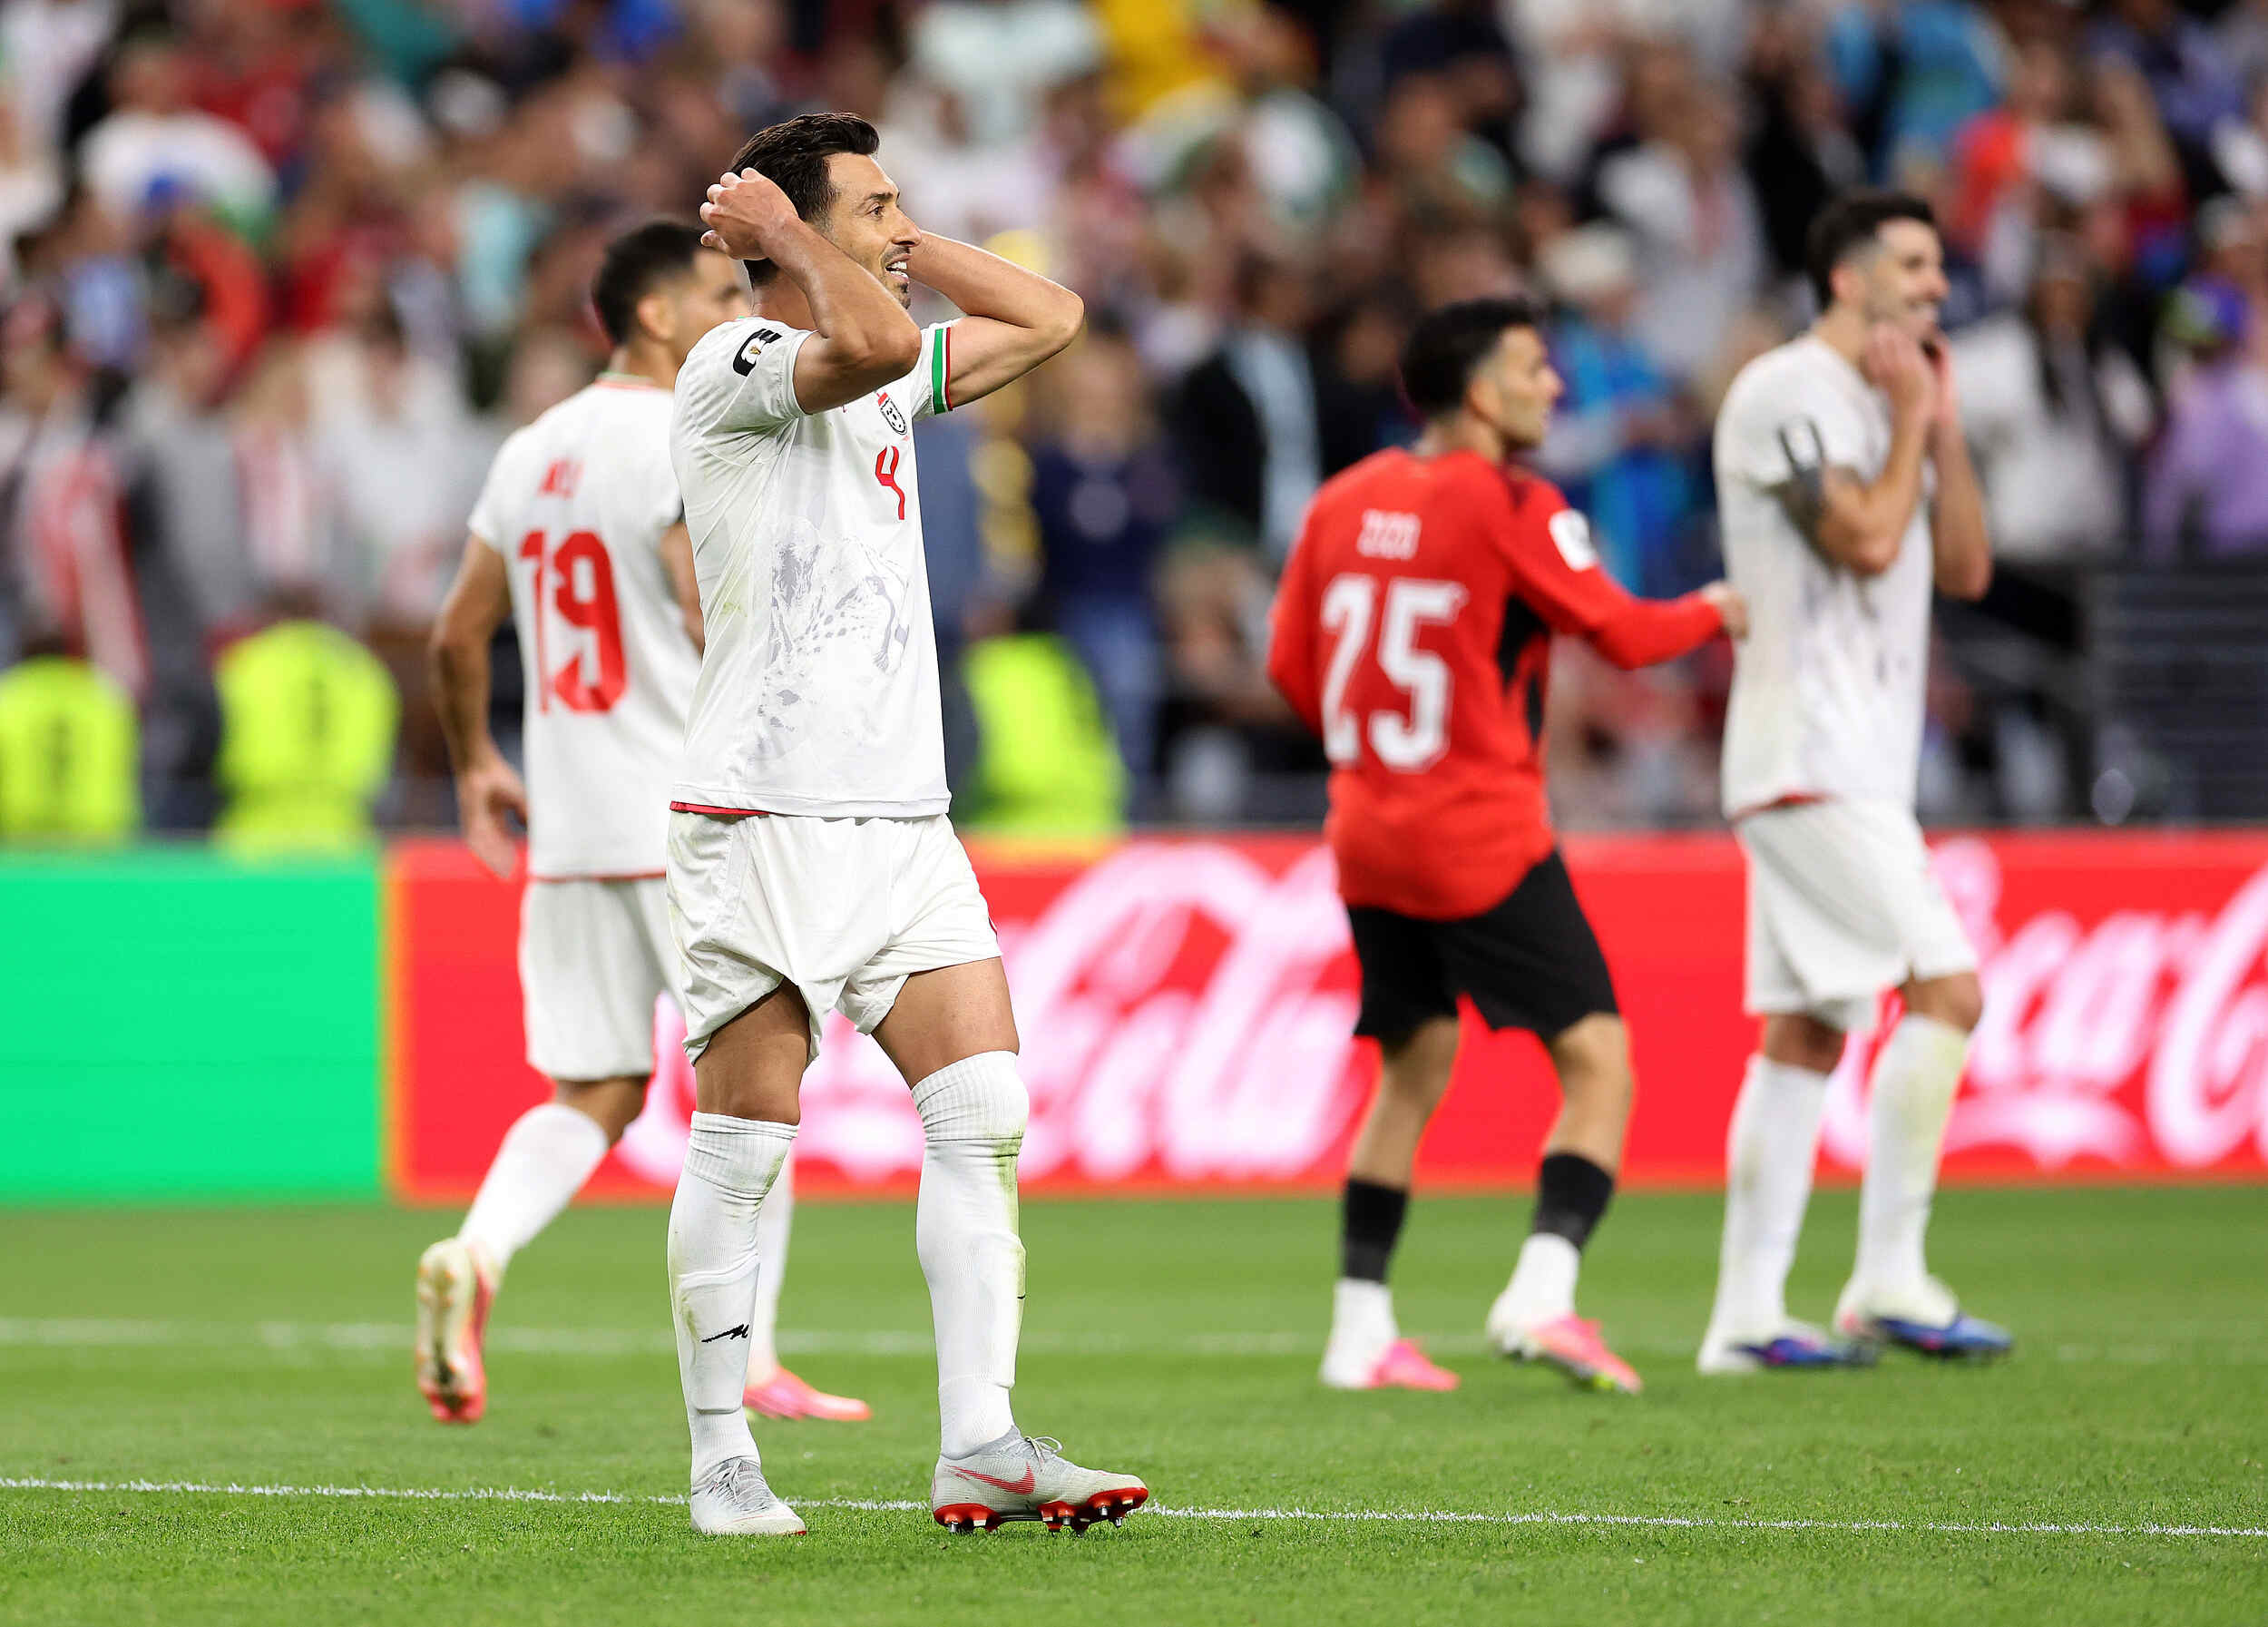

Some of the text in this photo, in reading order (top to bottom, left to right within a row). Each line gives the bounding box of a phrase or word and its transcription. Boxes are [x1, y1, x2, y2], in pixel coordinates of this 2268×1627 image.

[875, 445, 905, 520] 4
[519, 530, 628, 715] 19
[1320, 573, 1469, 772] 25
